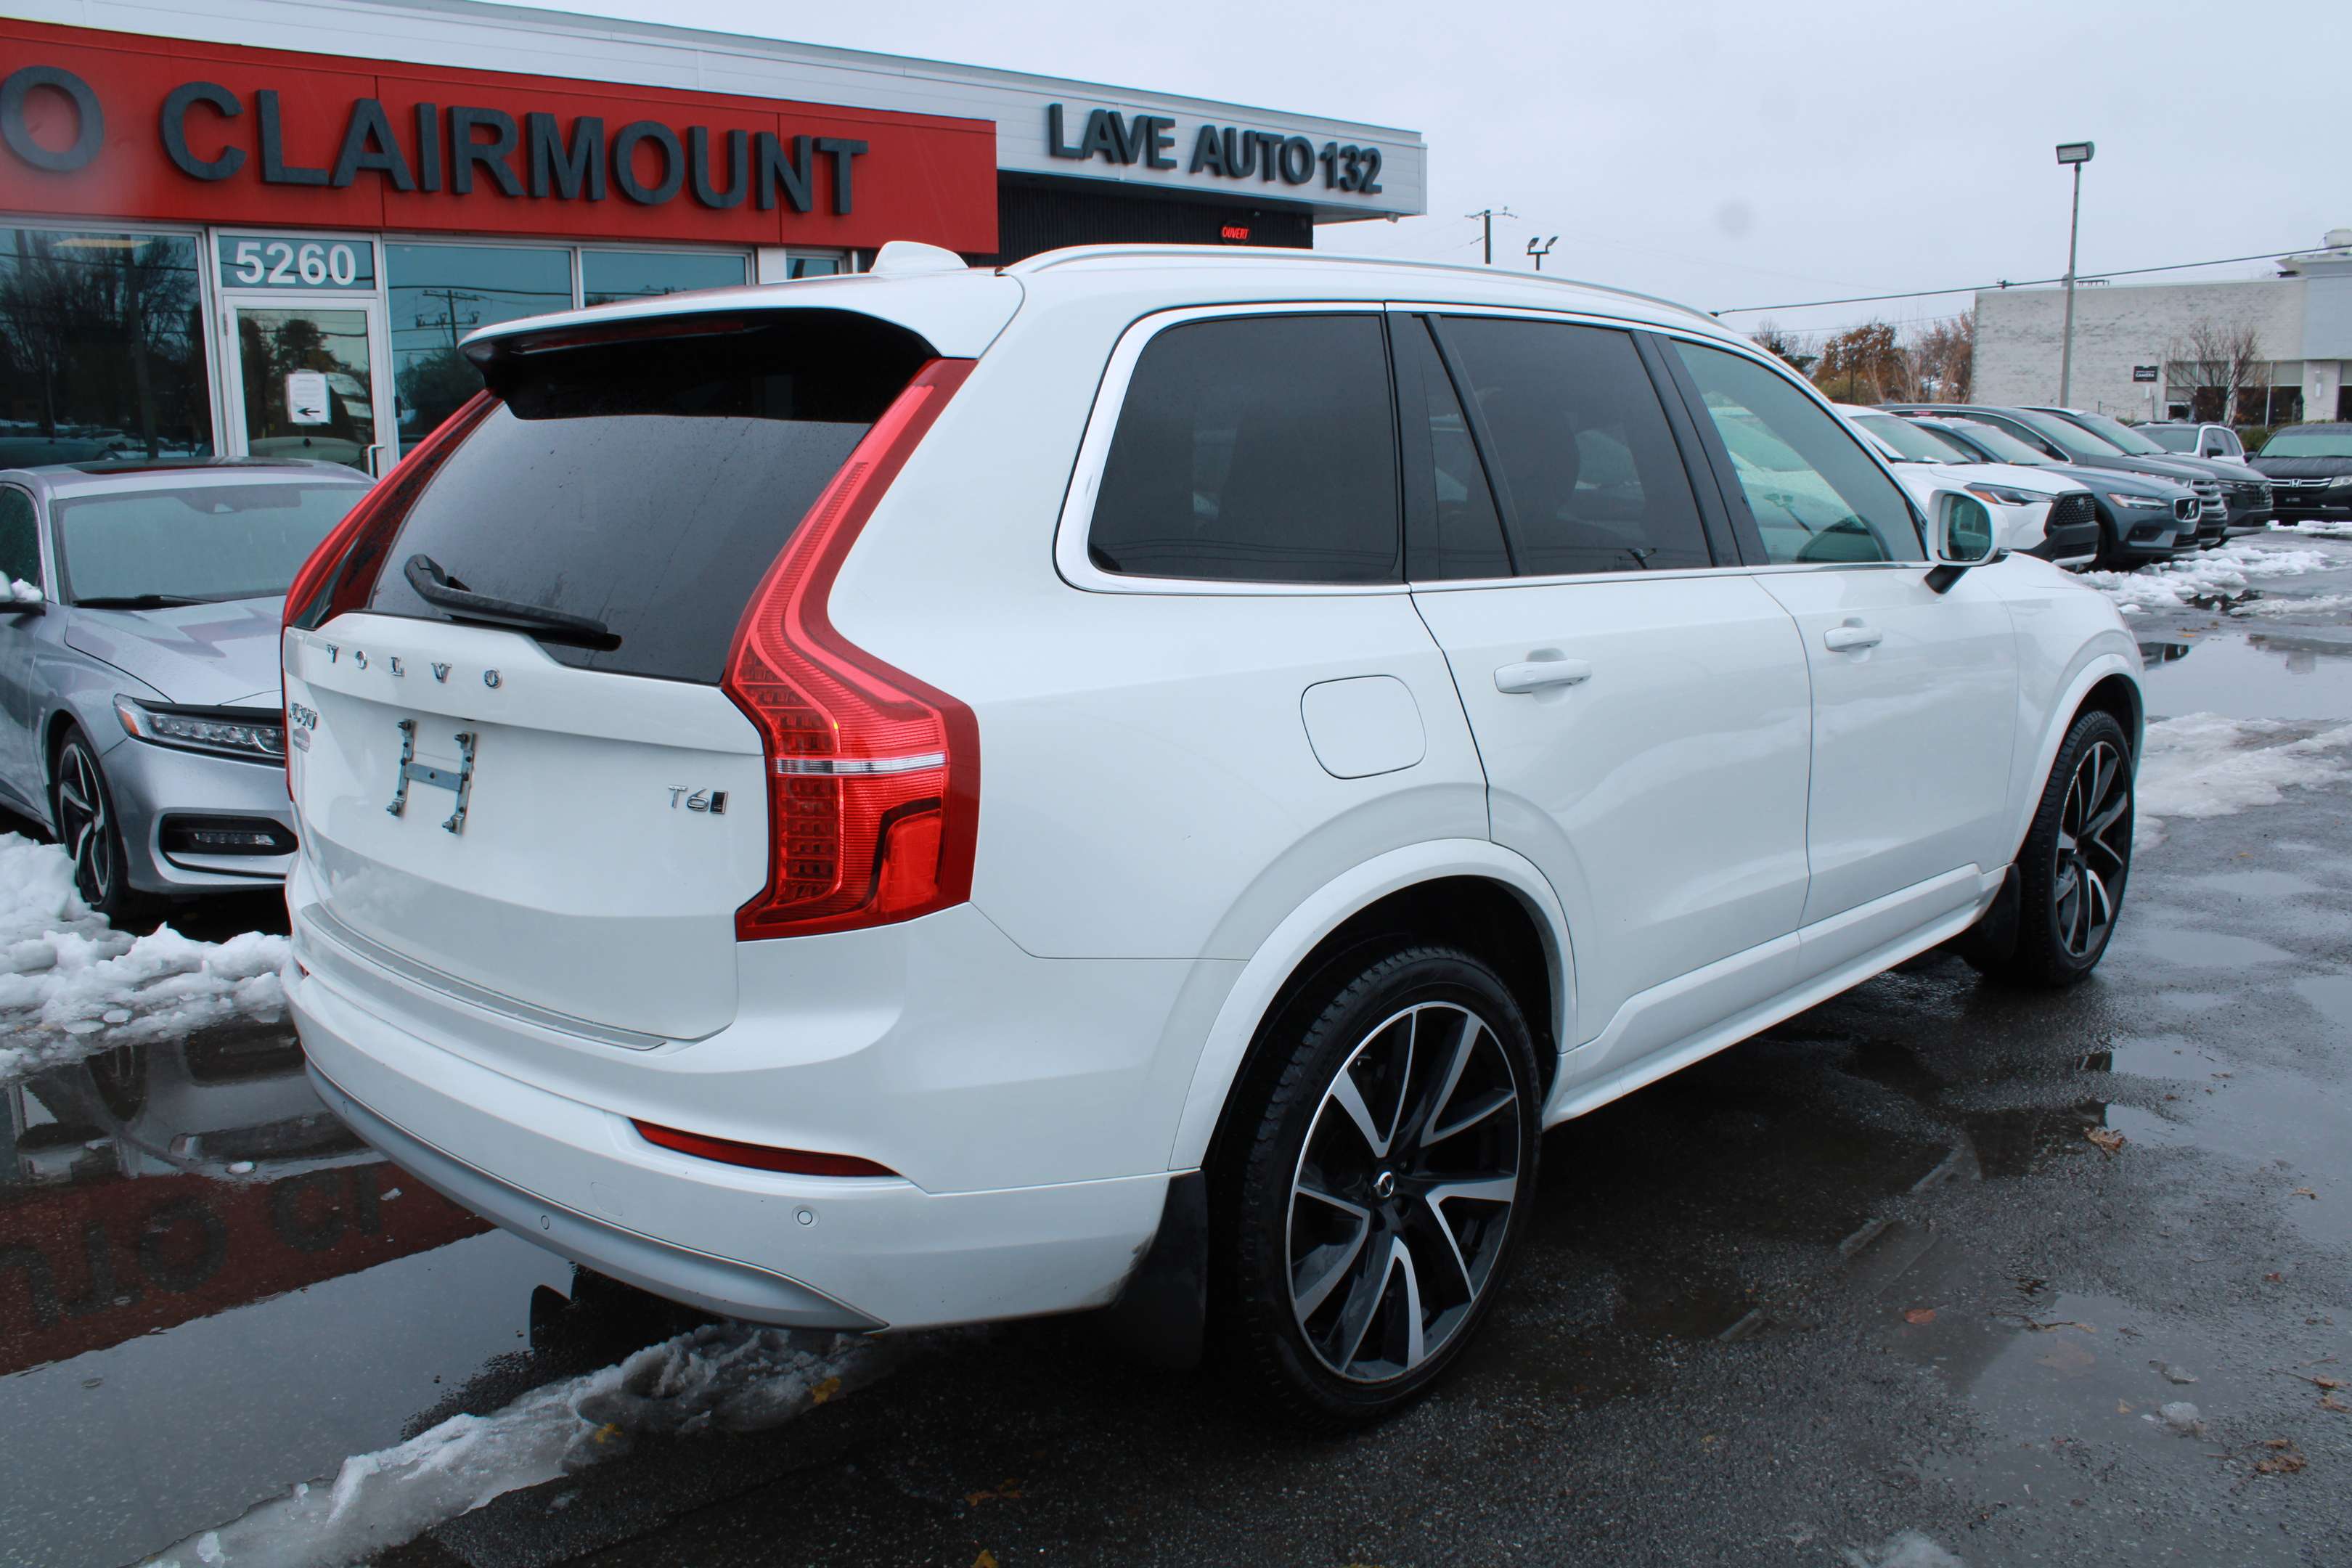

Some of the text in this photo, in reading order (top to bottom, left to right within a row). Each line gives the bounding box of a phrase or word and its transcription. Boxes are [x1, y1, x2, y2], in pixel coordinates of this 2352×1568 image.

[159, 81, 869, 216] CLAIRMOUNT
[1048, 103, 1382, 194] LAVE AUTO 132
[1222, 226, 1249, 240] OUVERT
[235, 241, 356, 285] 5260
[327, 643, 503, 689] VOLVO
[668, 784, 709, 812] T6
